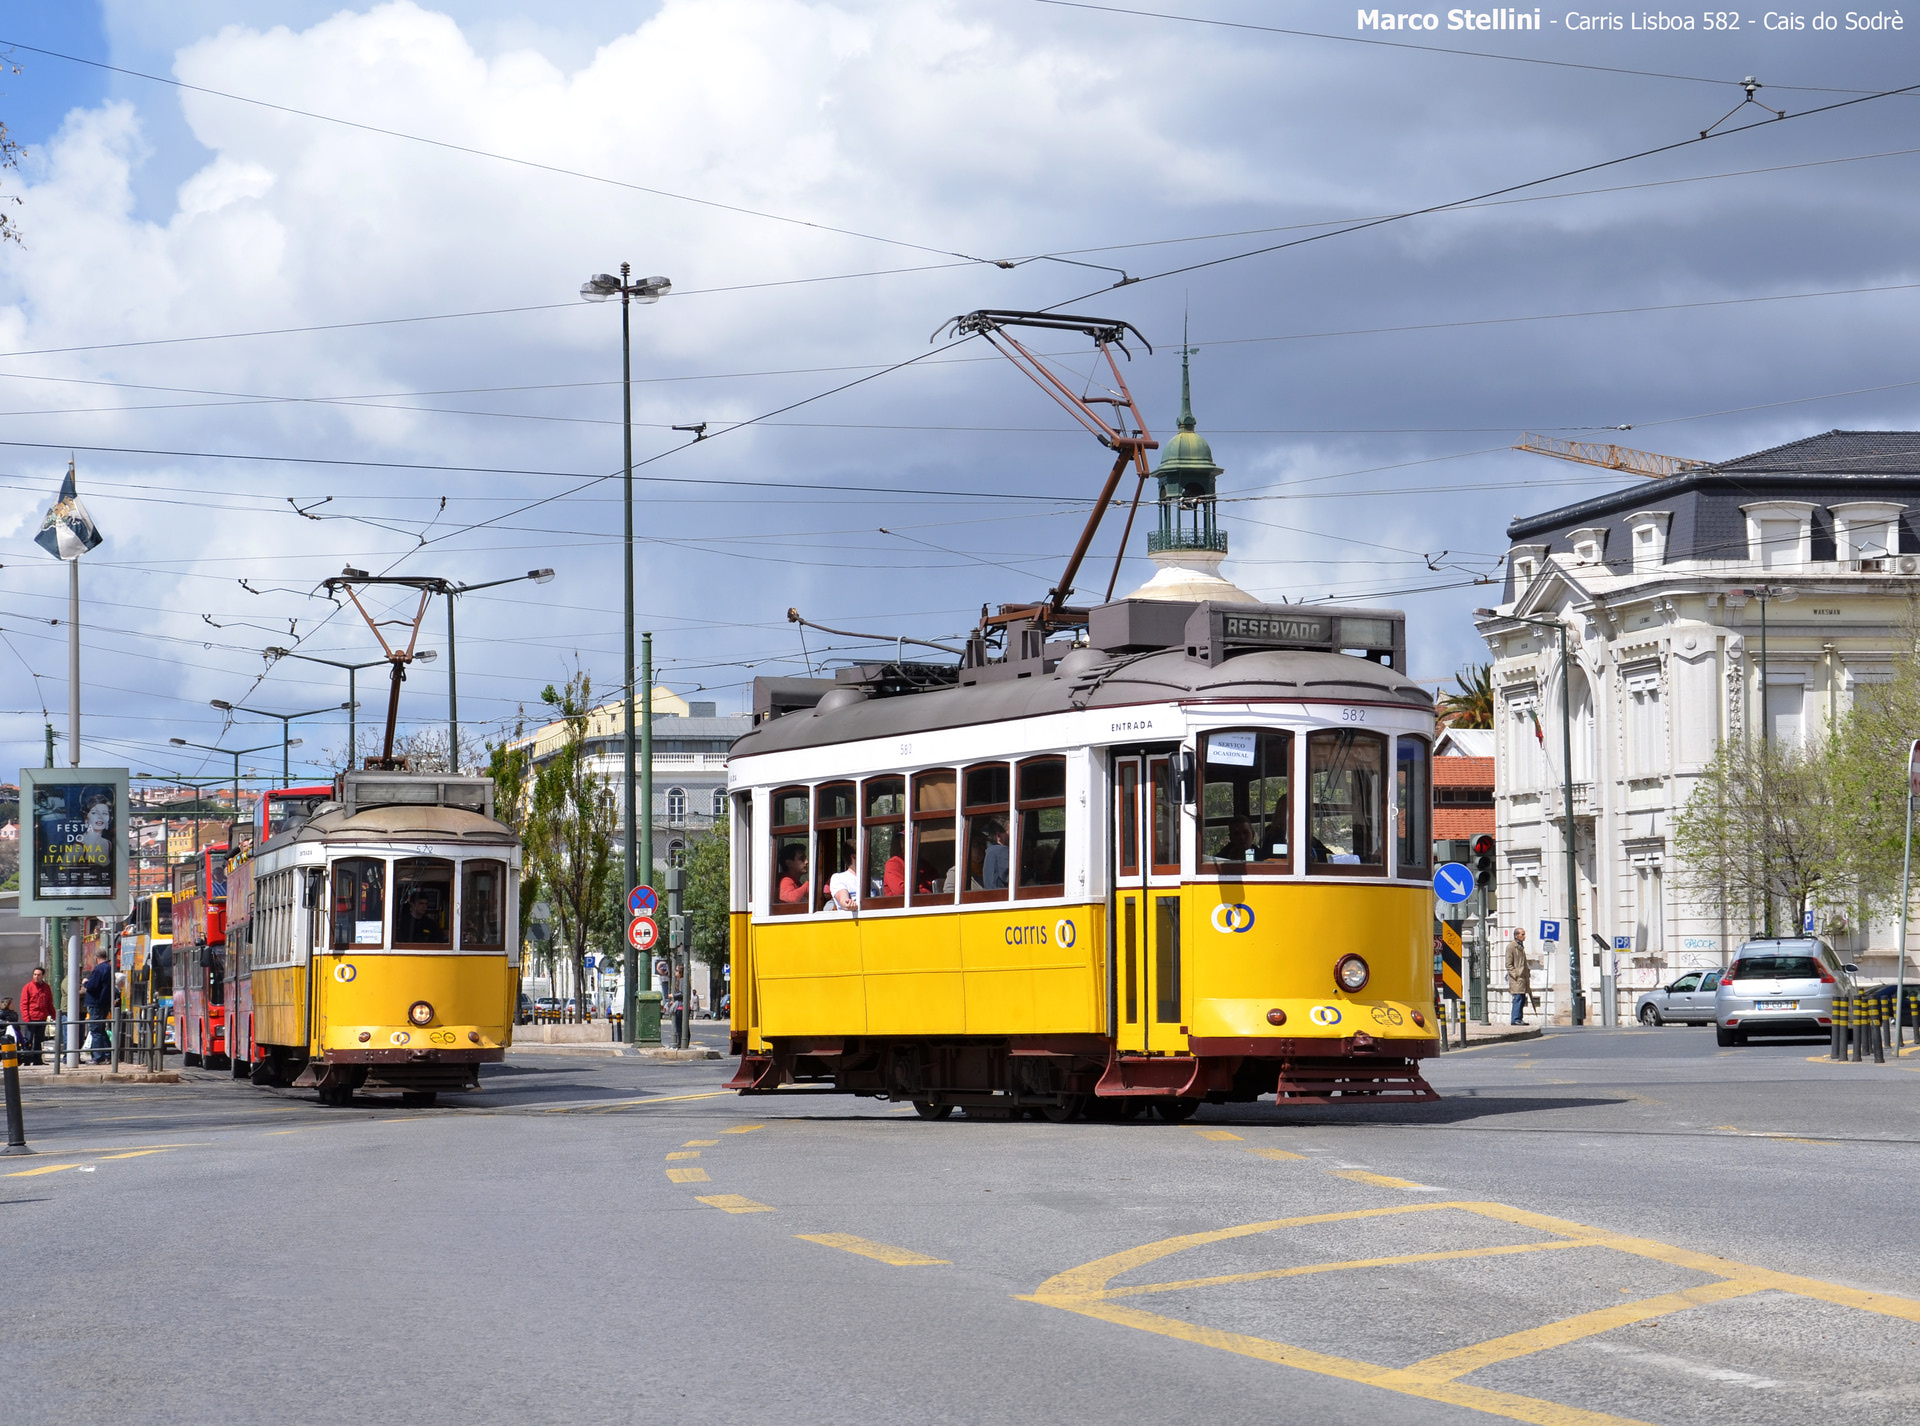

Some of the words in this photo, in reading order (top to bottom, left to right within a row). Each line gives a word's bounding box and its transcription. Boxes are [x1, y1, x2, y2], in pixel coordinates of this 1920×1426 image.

[1228, 618, 1320, 640] RESERVADO
[1342, 709, 1366, 721] 582
[1111, 720, 1153, 732] ENTRADA
[900, 743, 912, 756] 582
[1218, 742, 1246, 750] SERVIÇO
[57, 824, 94, 833] FESTA
[67, 834, 84, 843] DO
[49, 844, 103, 853] CINEMA
[44, 855, 107, 864] ITALIANO
[1805, 913, 1812, 928] P
[1005, 925, 1047, 945] carris
[1544, 923, 1555, 937] P
[1616, 938, 1624, 948] P
[586, 958, 594, 966] P
